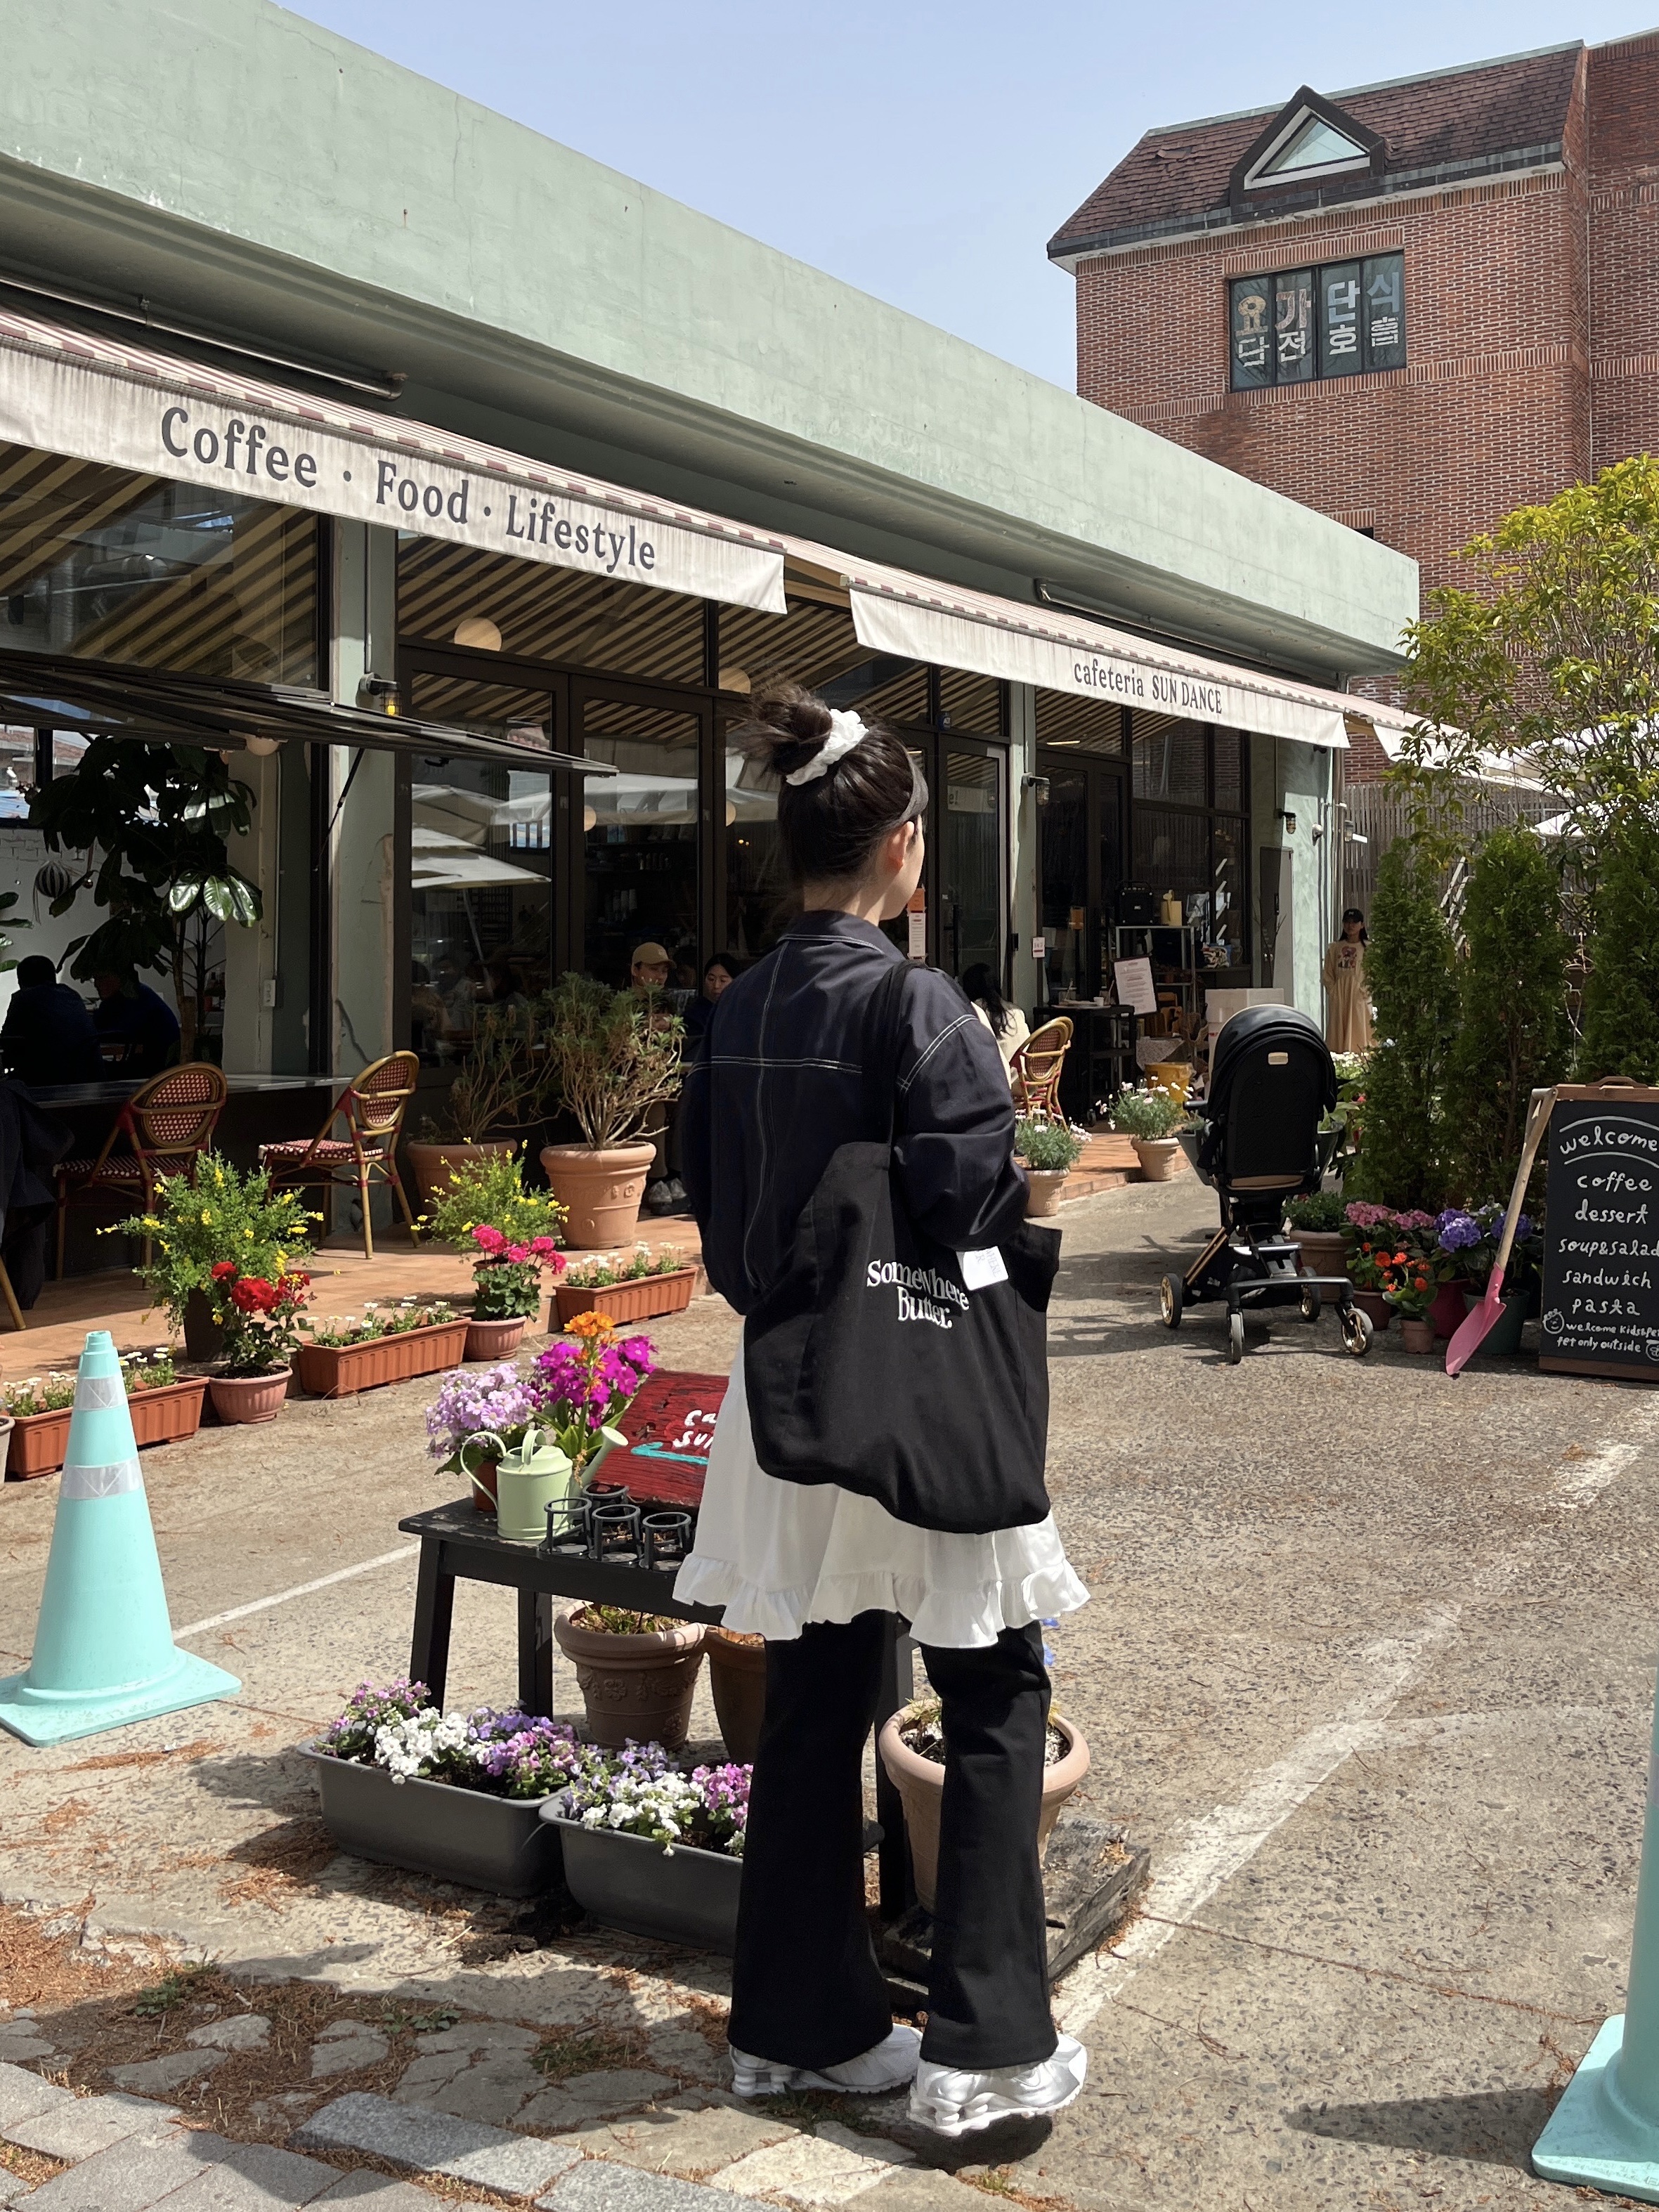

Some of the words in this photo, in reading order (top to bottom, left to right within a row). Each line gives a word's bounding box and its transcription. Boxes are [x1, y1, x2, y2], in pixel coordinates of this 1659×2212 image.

[1235, 288, 1312, 337] 요가
[1327, 272, 1400, 324] 단식
[1238, 316, 1399, 367] 단전호흡
[161, 406, 318, 488] Coffee
[376, 460, 469, 524] Food
[505, 494, 656, 573] Lifestyle
[1074, 658, 1145, 698] cafeteria
[1559, 1125, 1658, 1154] welcome
[1577, 1171, 1653, 1193] coffee
[1575, 1198, 1649, 1225] dessert
[1562, 1268, 1652, 1289] sandwich
[1572, 1298, 1641, 1316] pasta
[1566, 1322, 1617, 1334] welcome
[1577, 1336, 1599, 1351] only
[1600, 1338, 1641, 1353] outside
[684, 1409, 717, 1426] Ca
